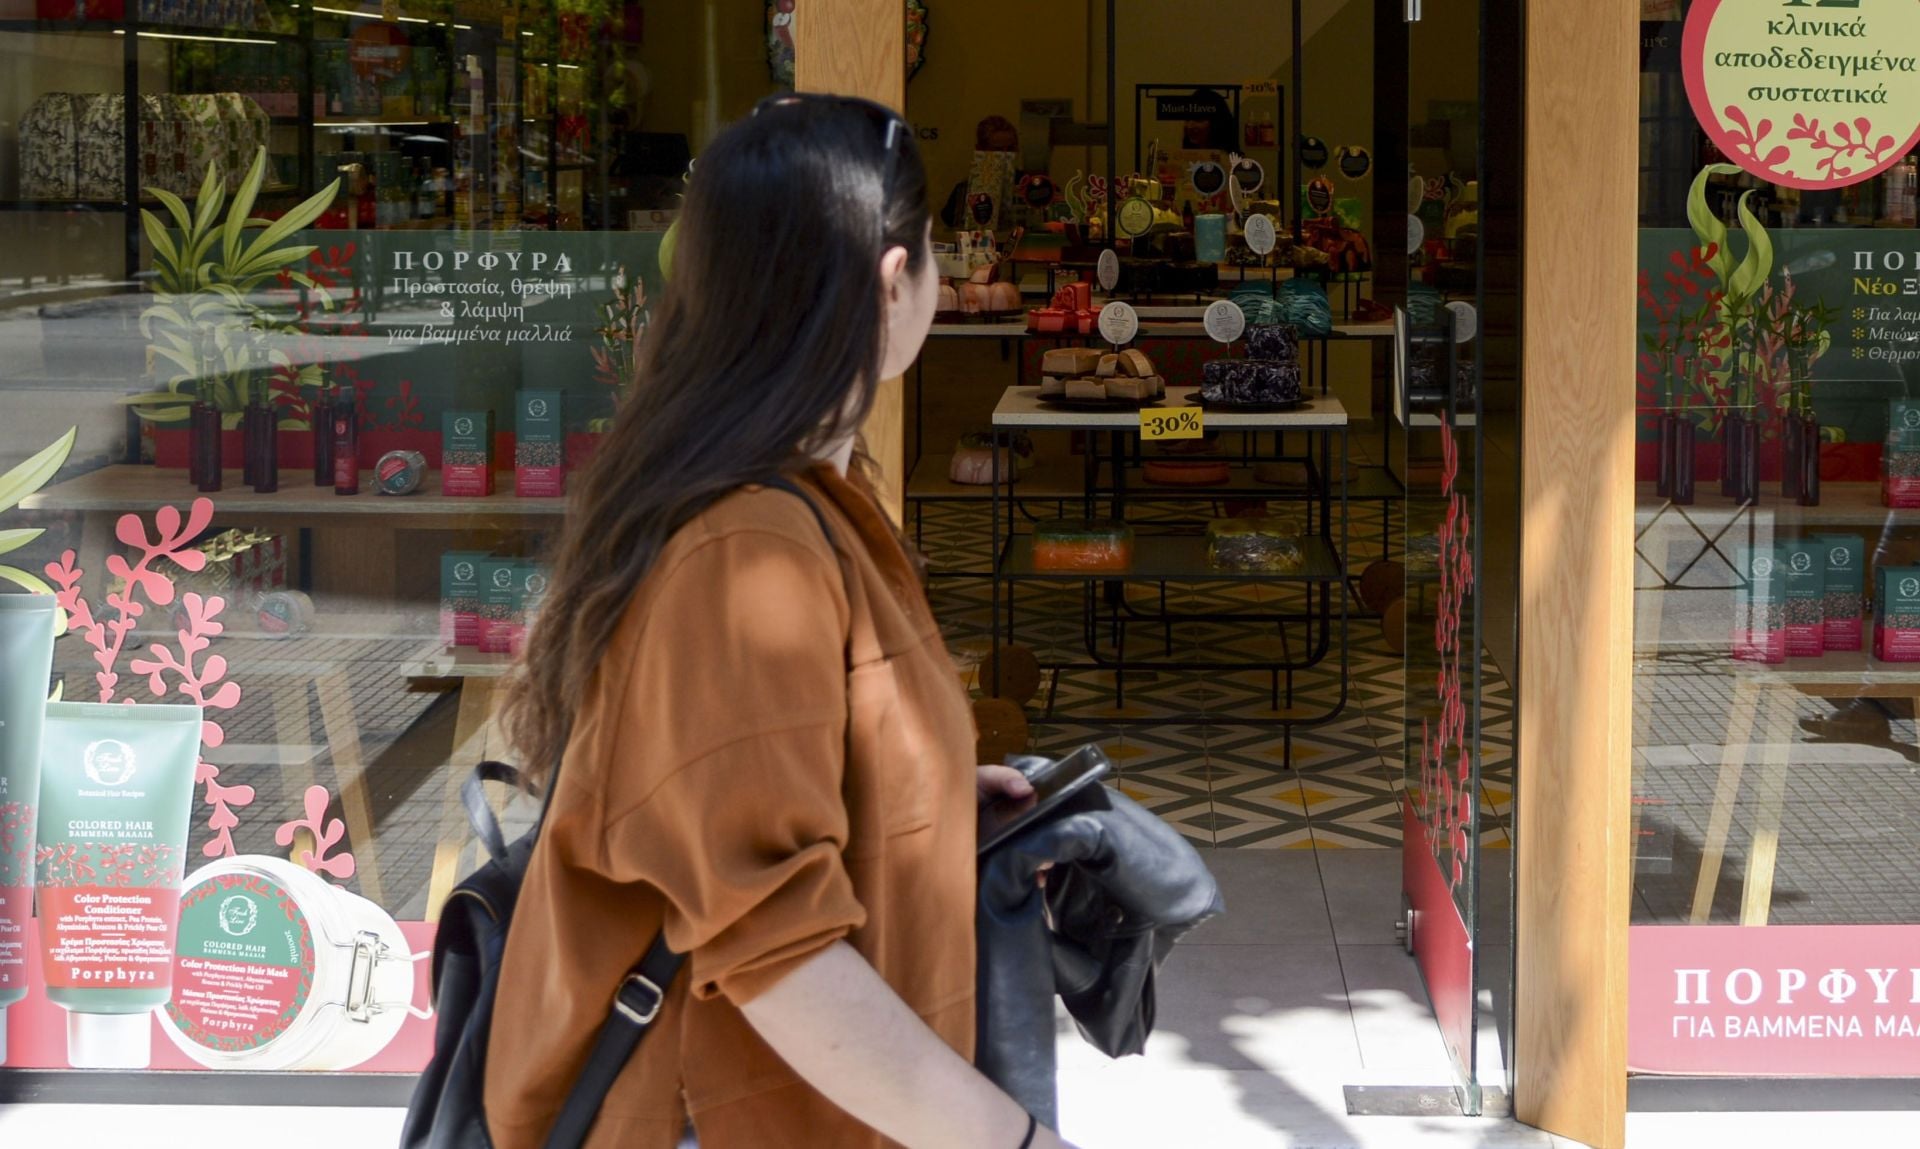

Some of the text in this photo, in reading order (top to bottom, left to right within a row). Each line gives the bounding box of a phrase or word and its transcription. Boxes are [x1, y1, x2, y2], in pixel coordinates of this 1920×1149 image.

[1766, 13, 1868, 38] κλινικά
[1714, 46, 1917, 77] αποδεδειγμένα
[1747, 82, 1888, 104] συστατικά
[1161, 102, 1217, 113] Must-Haves
[393, 251, 572, 272] ΠΟΡΦΥΡΑ
[393, 277, 572, 299] Προστασία, θρέψη
[1853, 276, 1920, 295] Νέο Ξ
[440, 301, 525, 322] & λάμψη
[1868, 307, 1891, 321] Για
[386, 324, 572, 346] για βαμμένα μαλλιά
[1143, 412, 1199, 436] -30%
[68, 820, 154, 831] COLORED HAIR
[68, 830, 114, 838] ΒΑΜΜΕΝΑ
[74, 894, 152, 904] Color Protection
[84, 905, 143, 915] Conditioner
[203, 940, 266, 953] COLORED HAIR
[71, 967, 155, 983] Porphyra
[180, 959, 203, 969] Color
[204, 961, 246, 973] Protection
[247, 966, 265, 976] Hair
[266, 968, 288, 978] Mask
[202, 1016, 254, 1031] Porphyra
[1672, 1015, 1920, 1038] ΓΙΑ ΒΑΜΜΕΝΑ ΜΑ
